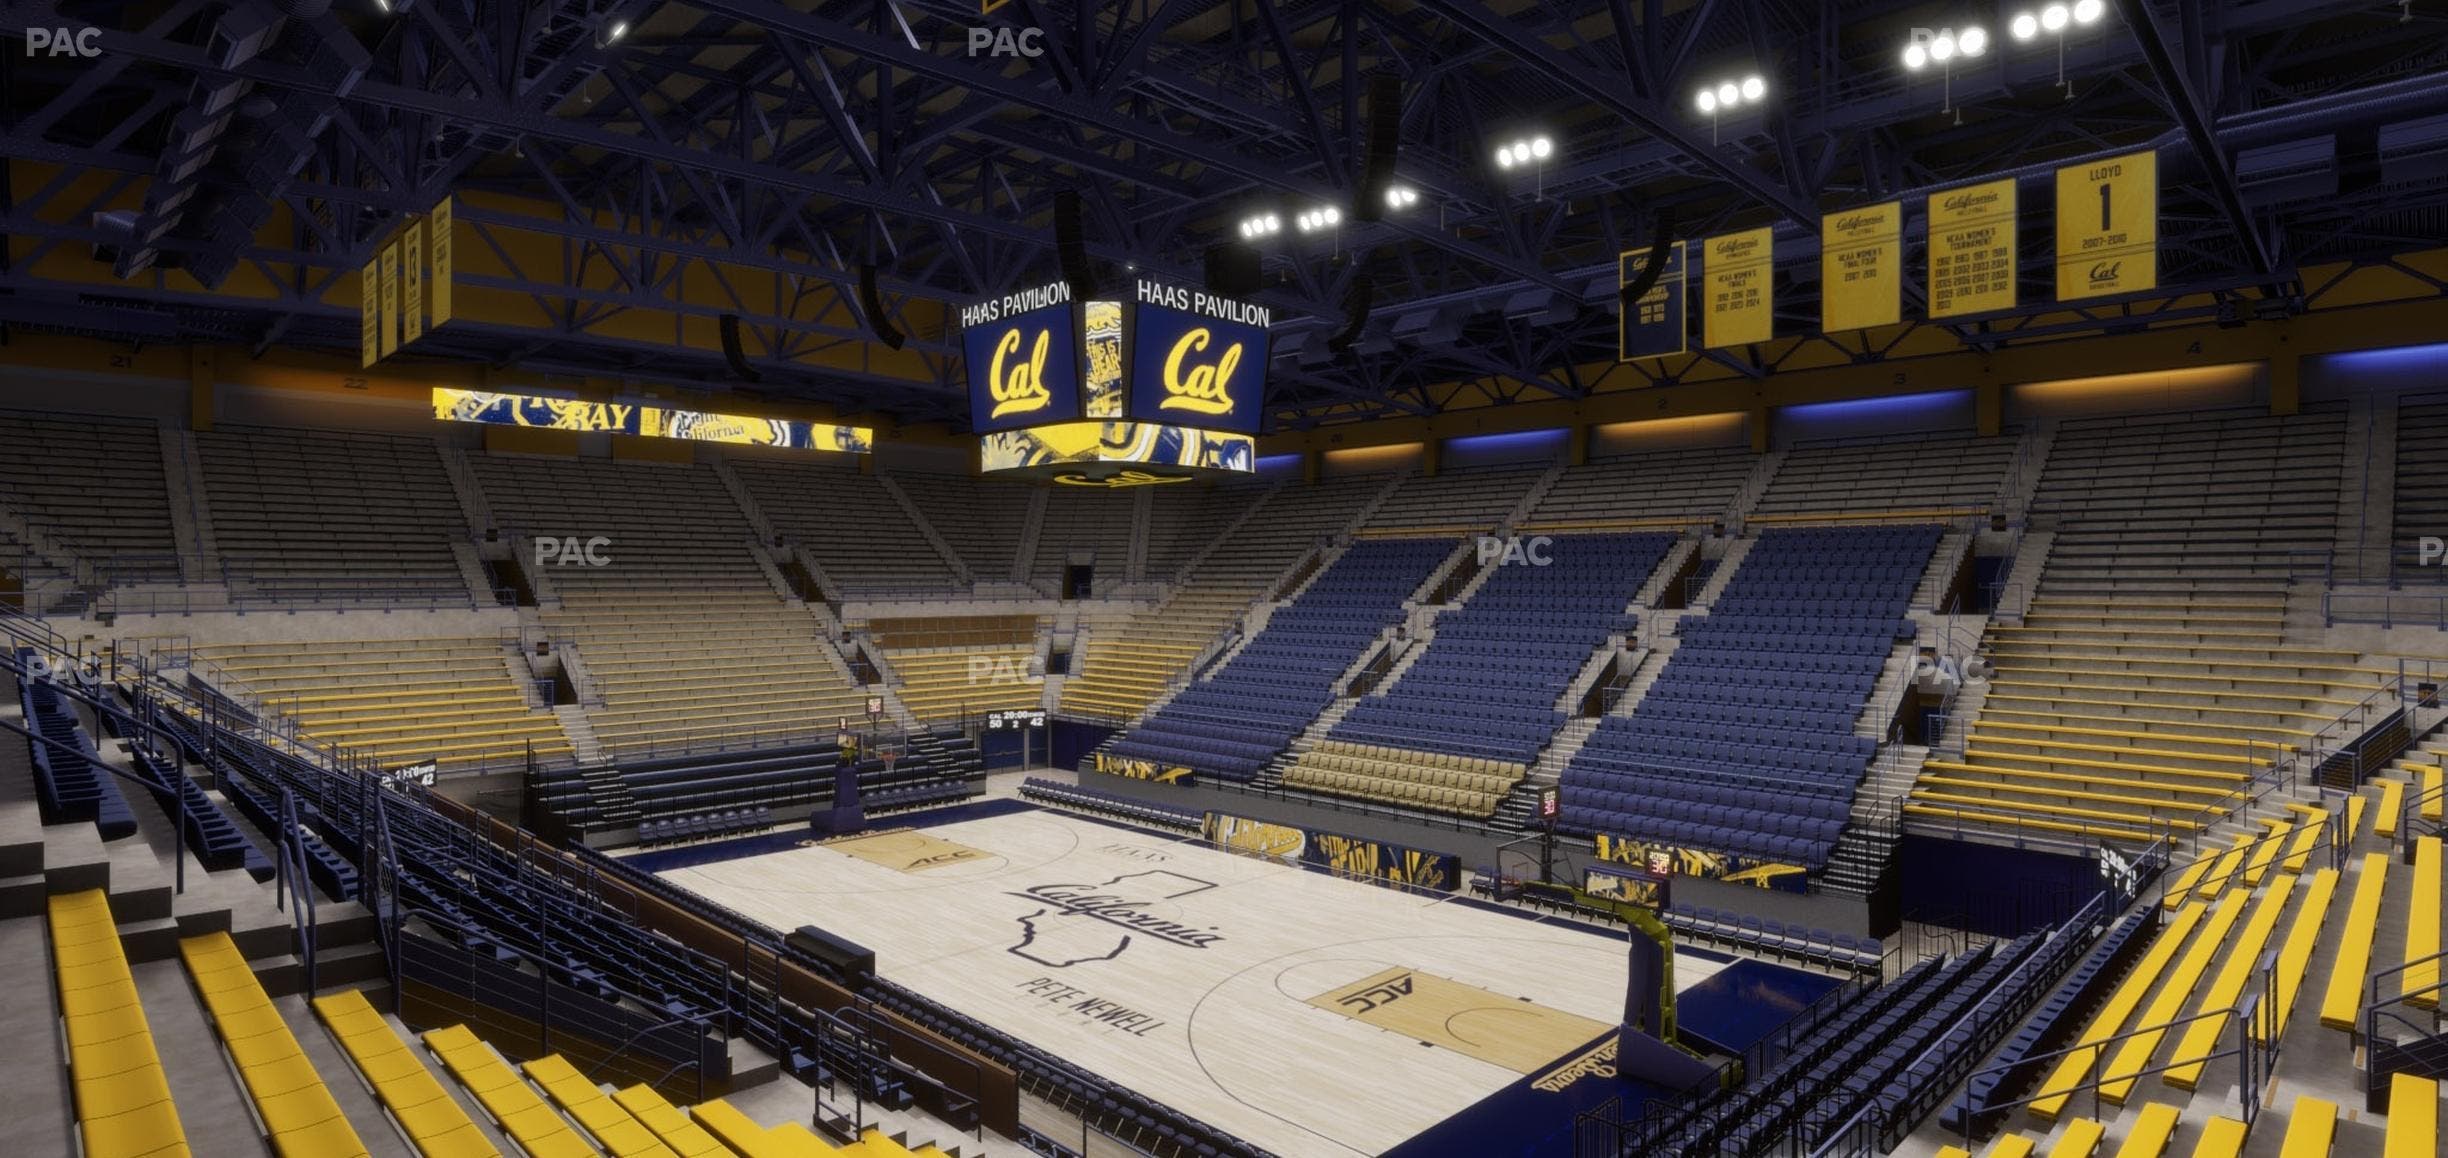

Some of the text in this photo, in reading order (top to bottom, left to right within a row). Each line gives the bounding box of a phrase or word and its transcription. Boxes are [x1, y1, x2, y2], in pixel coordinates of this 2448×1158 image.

[2090, 165, 2121, 181] LLOYD
[1944, 192, 1999, 211] California
[2099, 184, 2111, 231] 1
[1836, 215, 1885, 232] California
[2089, 261, 2122, 283] Cal
[962, 281, 1070, 328] HAAS PAVILION
[1138, 279, 1270, 328] HAAS PAVILION
[990, 328, 1051, 419] Cal
[1160, 328, 1243, 415] Cal
[989, 717, 1044, 728] 50 2 42
[1003, 711, 1028, 720] 20:00
[421, 773, 434, 785] 42
[903, 850, 976, 870] ACC
[1002, 884, 1228, 949] California
[1015, 977, 1166, 1037] PETE NEWELL
[1341, 977, 1413, 1014] ACC
